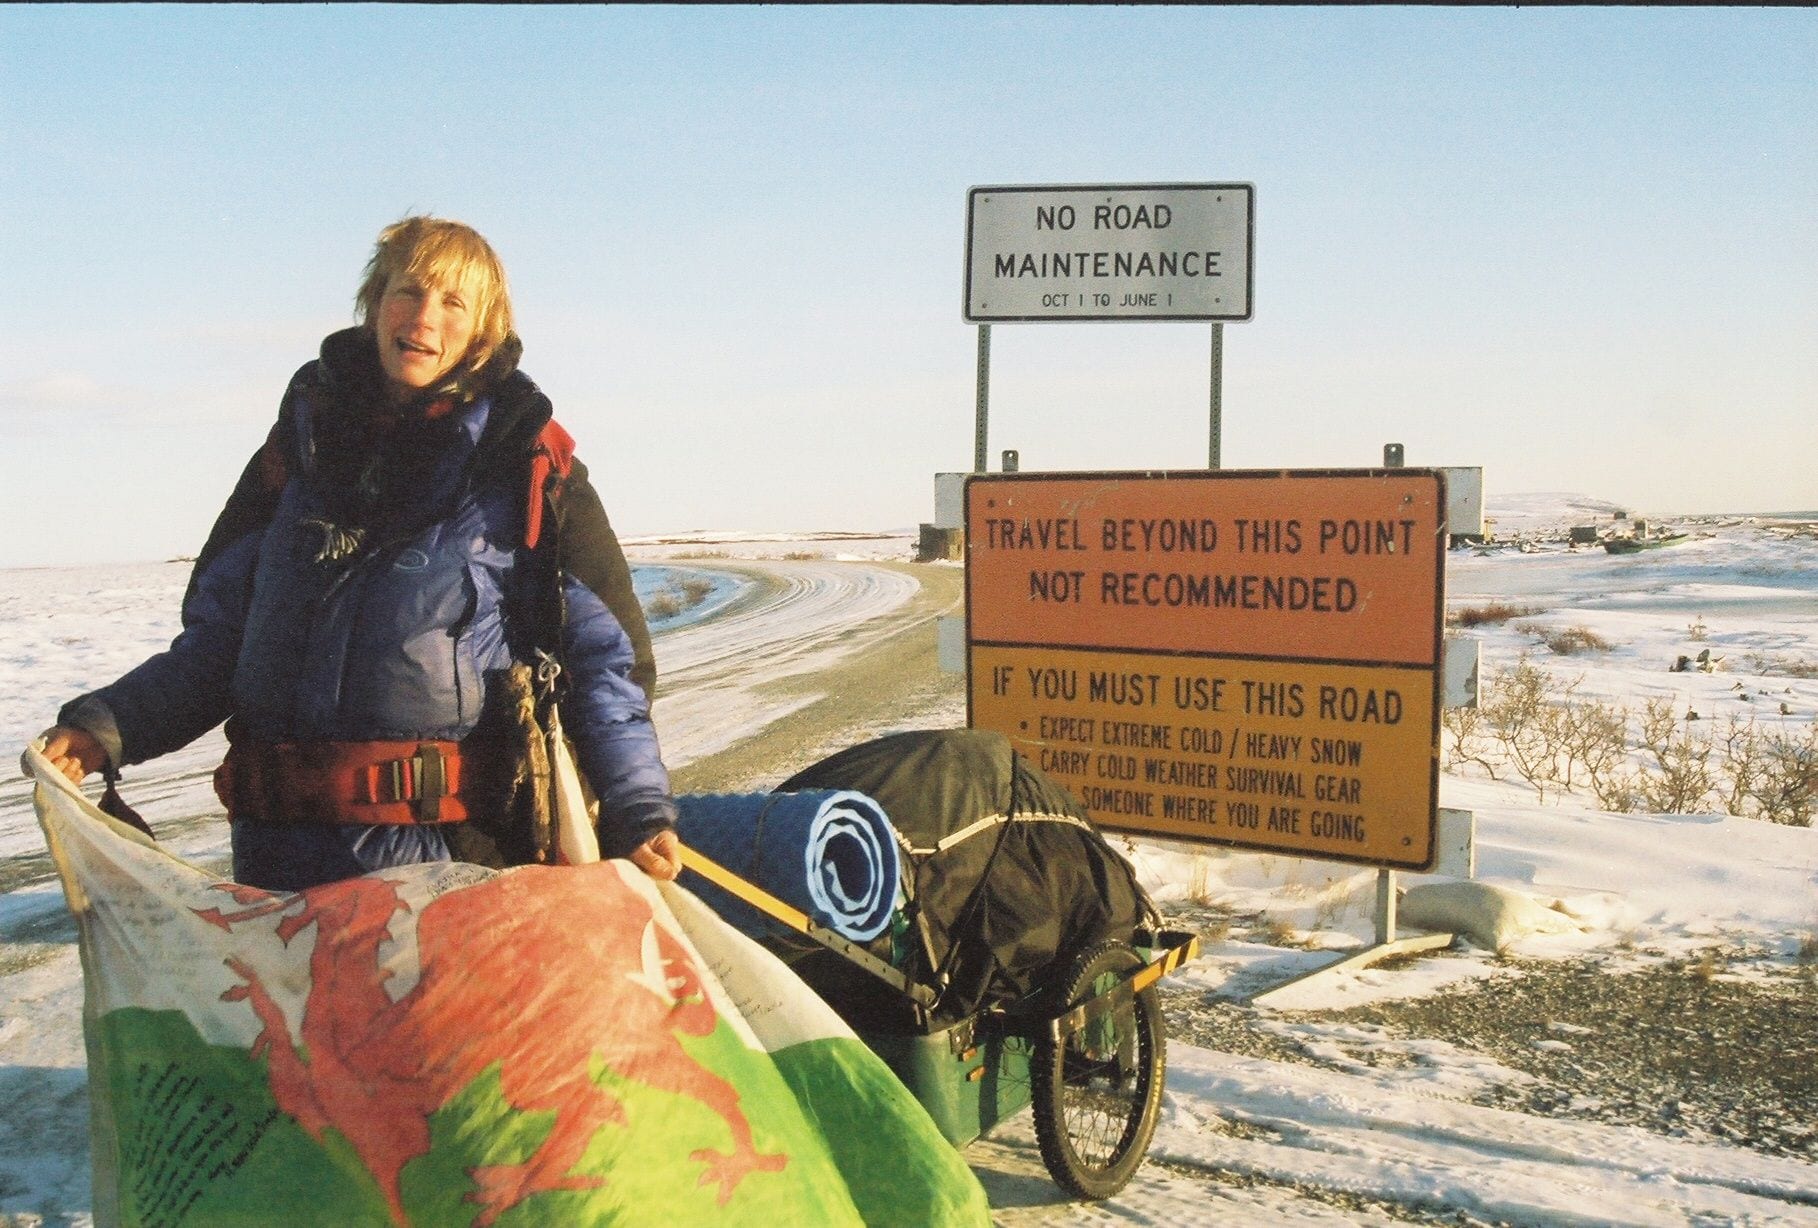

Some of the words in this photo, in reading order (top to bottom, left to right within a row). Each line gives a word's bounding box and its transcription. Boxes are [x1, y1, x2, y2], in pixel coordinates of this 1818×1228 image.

[1037, 205, 1076, 230] NO
[1094, 204, 1172, 230] ROAD
[994, 251, 1222, 278] MAINTENANCE
[1042, 294, 1069, 307] OCT
[1093, 294, 1110, 307] TO
[1120, 294, 1158, 307] JUNE
[985, 518, 1087, 552] TRAVEL
[1102, 519, 1217, 553] BEYOND
[1235, 519, 1302, 553] THIS
[1320, 519, 1416, 555] POINT
[1030, 571, 1085, 602] NOT
[1102, 572, 1358, 612] RECOMMENDED
[994, 666, 1013, 696] IF
[1028, 668, 1077, 701] YOU
[1089, 671, 1160, 706] MUST
[1175, 677, 1226, 712] USE
[1241, 681, 1304, 718] THIS
[1320, 685, 1402, 725] ROAD
[1040, 716, 1095, 743] EXPECT
[1102, 720, 1172, 749] EXTREME
[1181, 727, 1222, 754] COLD
[1229, 728, 1239, 759] /
[1247, 733, 1302, 761] HEAVY
[1311, 737, 1362, 767] SNOW
[1040, 748, 1091, 776] CARRY
[1097, 754, 1136, 781] COLD
[1145, 758, 1217, 789] WEATHER
[1226, 766, 1305, 799] SURVIVAL
[1315, 774, 1361, 804] GEAR
[1081, 785, 1154, 817] SOMEONE
[1163, 794, 1216, 824] WHERE
[1226, 801, 1259, 830] YOU
[1267, 806, 1300, 834] ARE
[1311, 810, 1365, 843] GOING
